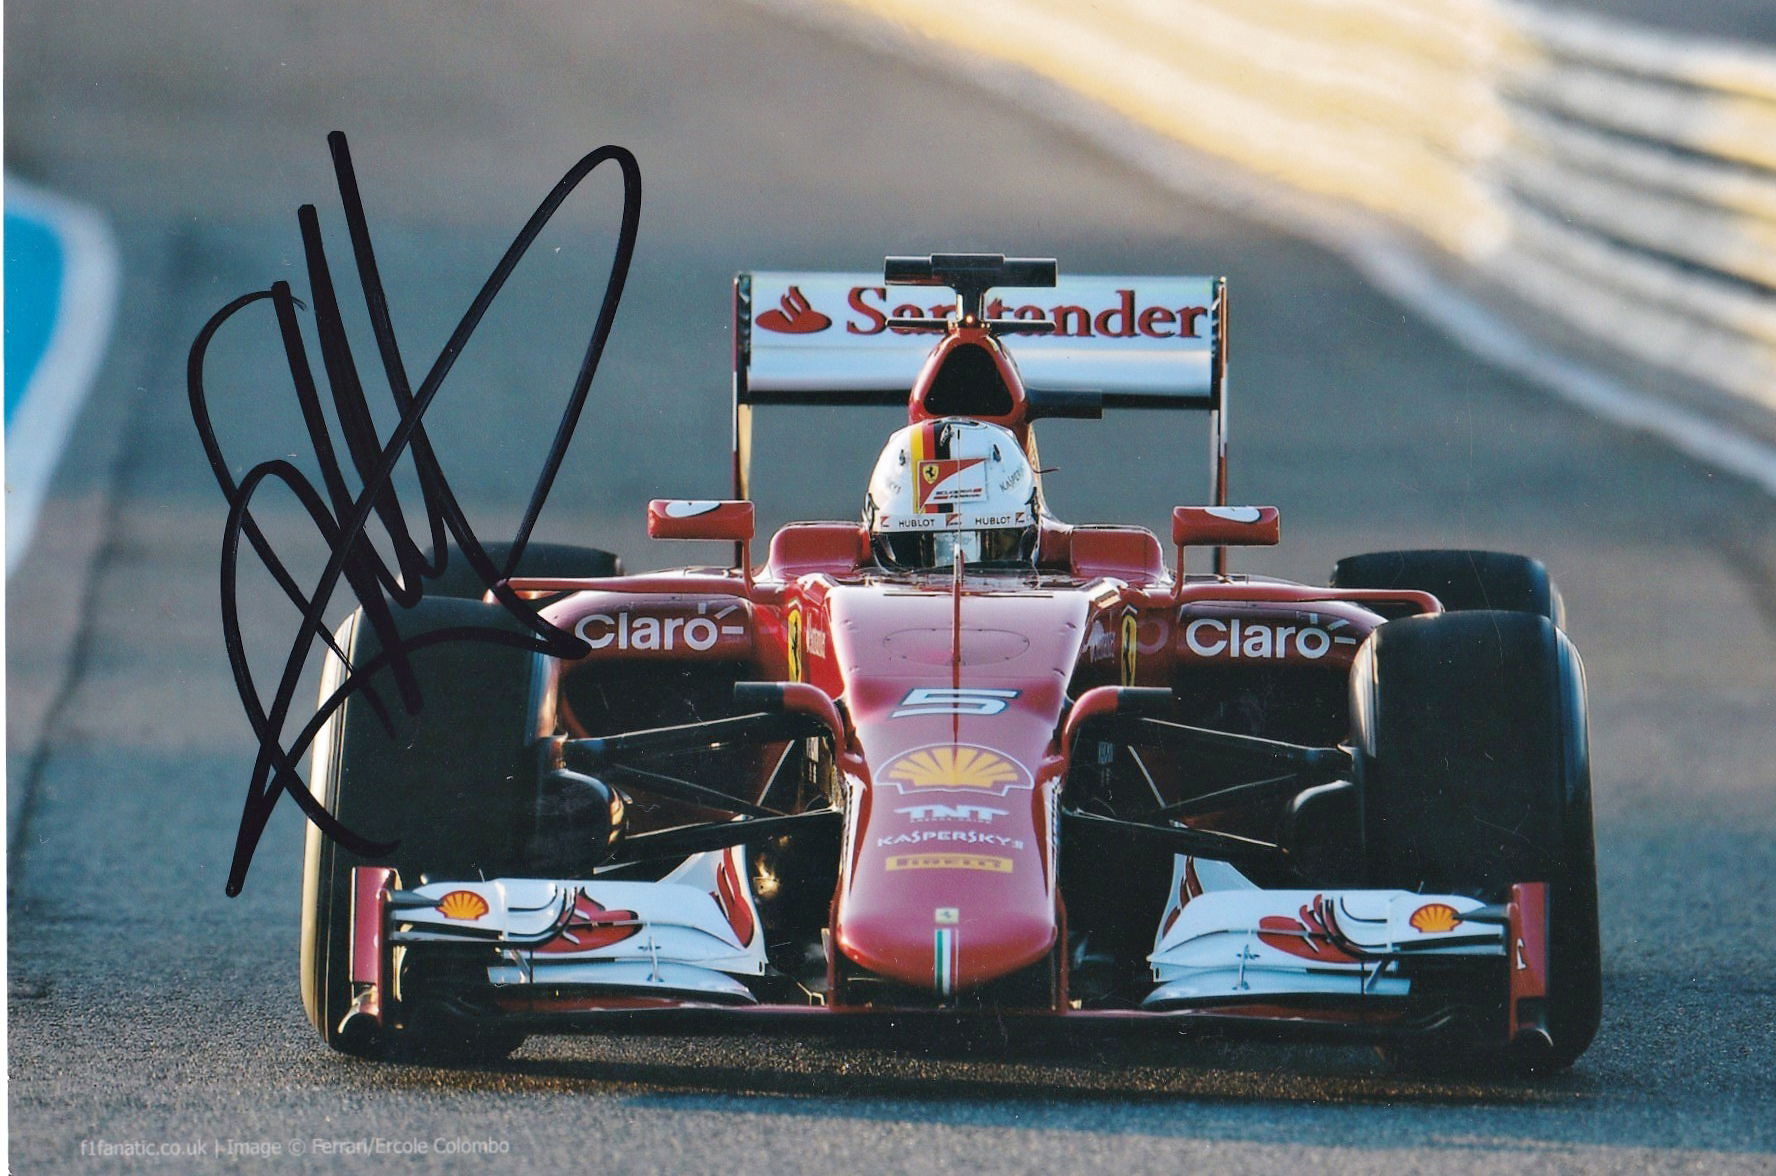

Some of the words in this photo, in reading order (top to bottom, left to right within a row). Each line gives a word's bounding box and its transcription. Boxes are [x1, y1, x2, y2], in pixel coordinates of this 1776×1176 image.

[898, 518, 936, 528] HUBLOT
[975, 516, 1011, 526] HUBLOT
[890, 687, 1023, 719] 5
[893, 804, 1010, 822] TNT
[876, 829, 1011, 848] KASPERSKY
